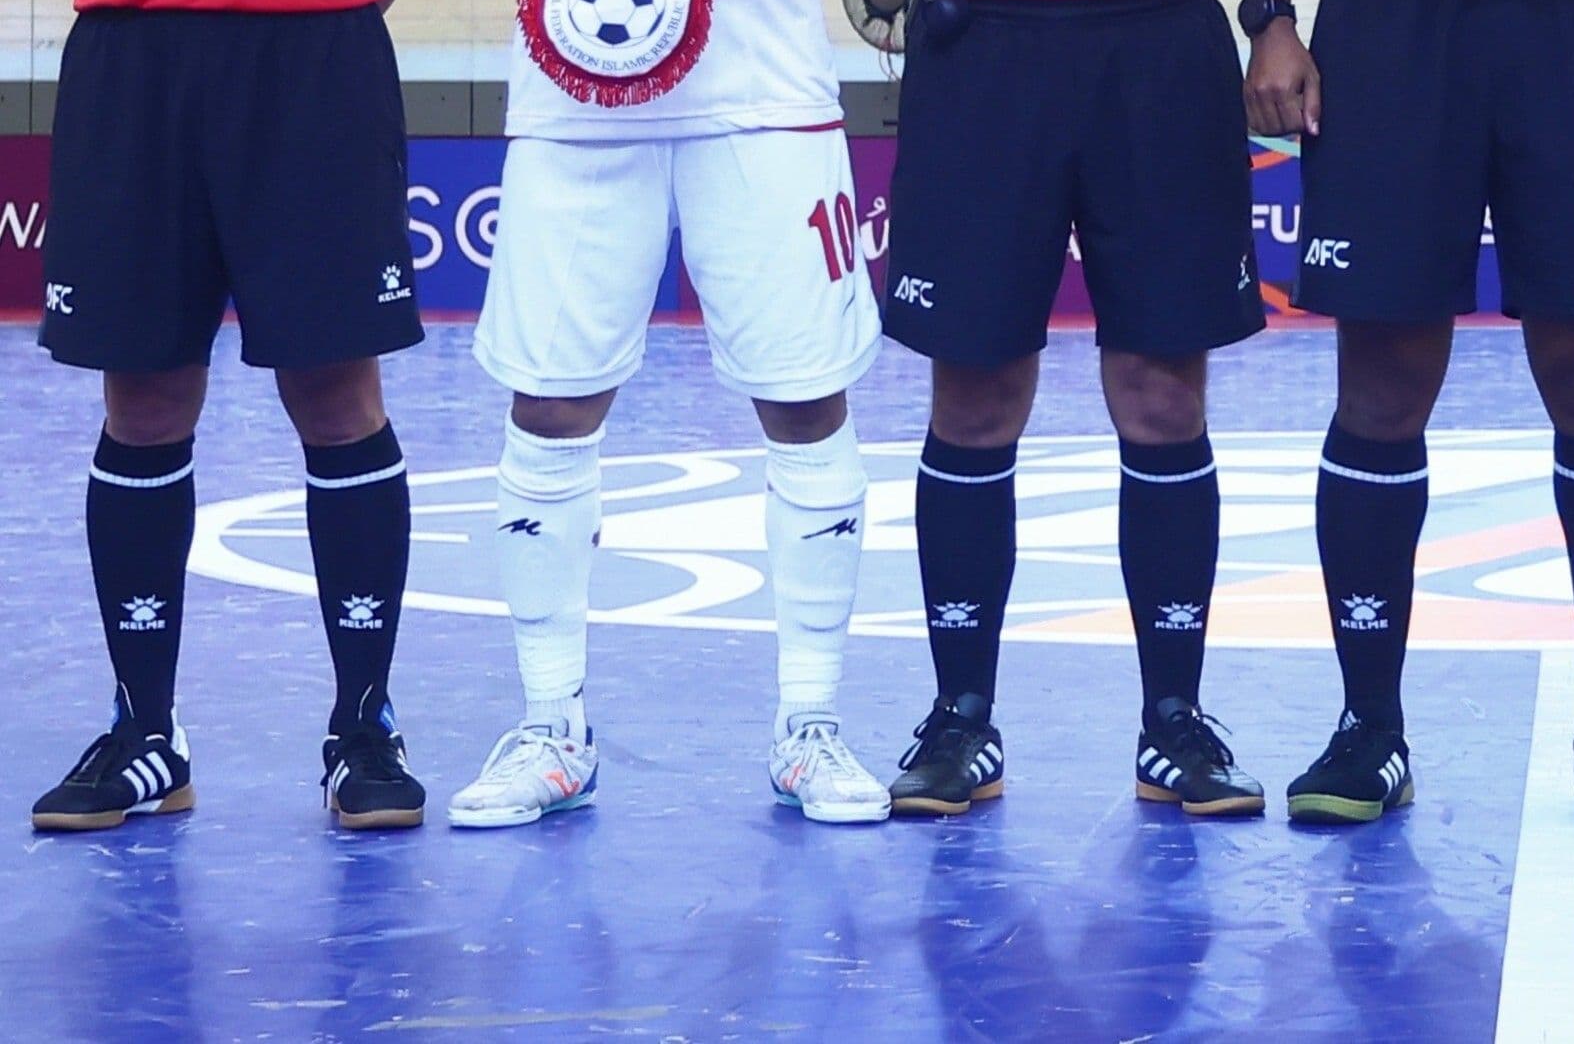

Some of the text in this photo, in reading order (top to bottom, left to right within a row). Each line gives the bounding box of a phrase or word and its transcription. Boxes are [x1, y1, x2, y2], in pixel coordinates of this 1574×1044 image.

[551, 9, 600, 66] FEDERATION
[602, 53, 652, 71] ISLAMIC
[808, 191, 854, 282] 10
[1304, 238, 1350, 269] AFC
[378, 287, 412, 303] KELME
[894, 276, 934, 308] AFC
[119, 619, 166, 630] KELME
[338, 618, 384, 629] KELME
[930, 618, 979, 628] KELME
[1154, 620, 1203, 629] KELME
[1340, 618, 1389, 630] KELME
